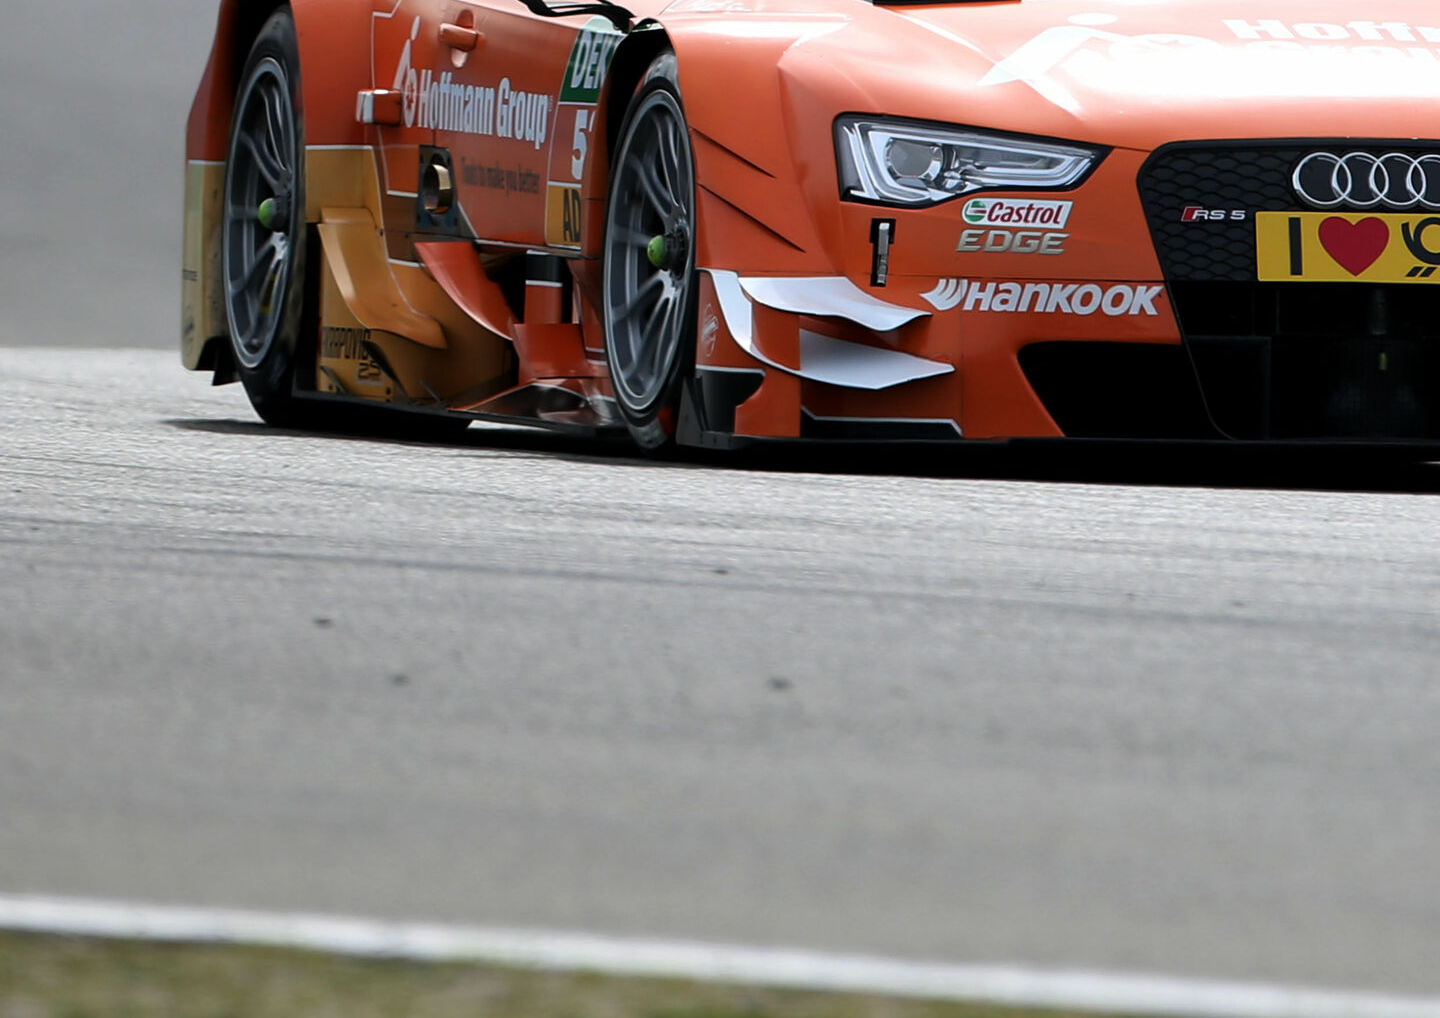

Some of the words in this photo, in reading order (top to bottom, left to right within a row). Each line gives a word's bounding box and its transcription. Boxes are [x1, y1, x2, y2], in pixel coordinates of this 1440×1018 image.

[418, 69, 495, 135] Hoffmann
[497, 77, 549, 150] Group
[571, 109, 595, 180] 5
[987, 201, 1063, 225] Castrol
[1191, 209, 1226, 221] RS
[1230, 209, 1246, 220] 5
[955, 229, 1070, 255] EDGE
[1288, 217, 1303, 276] I
